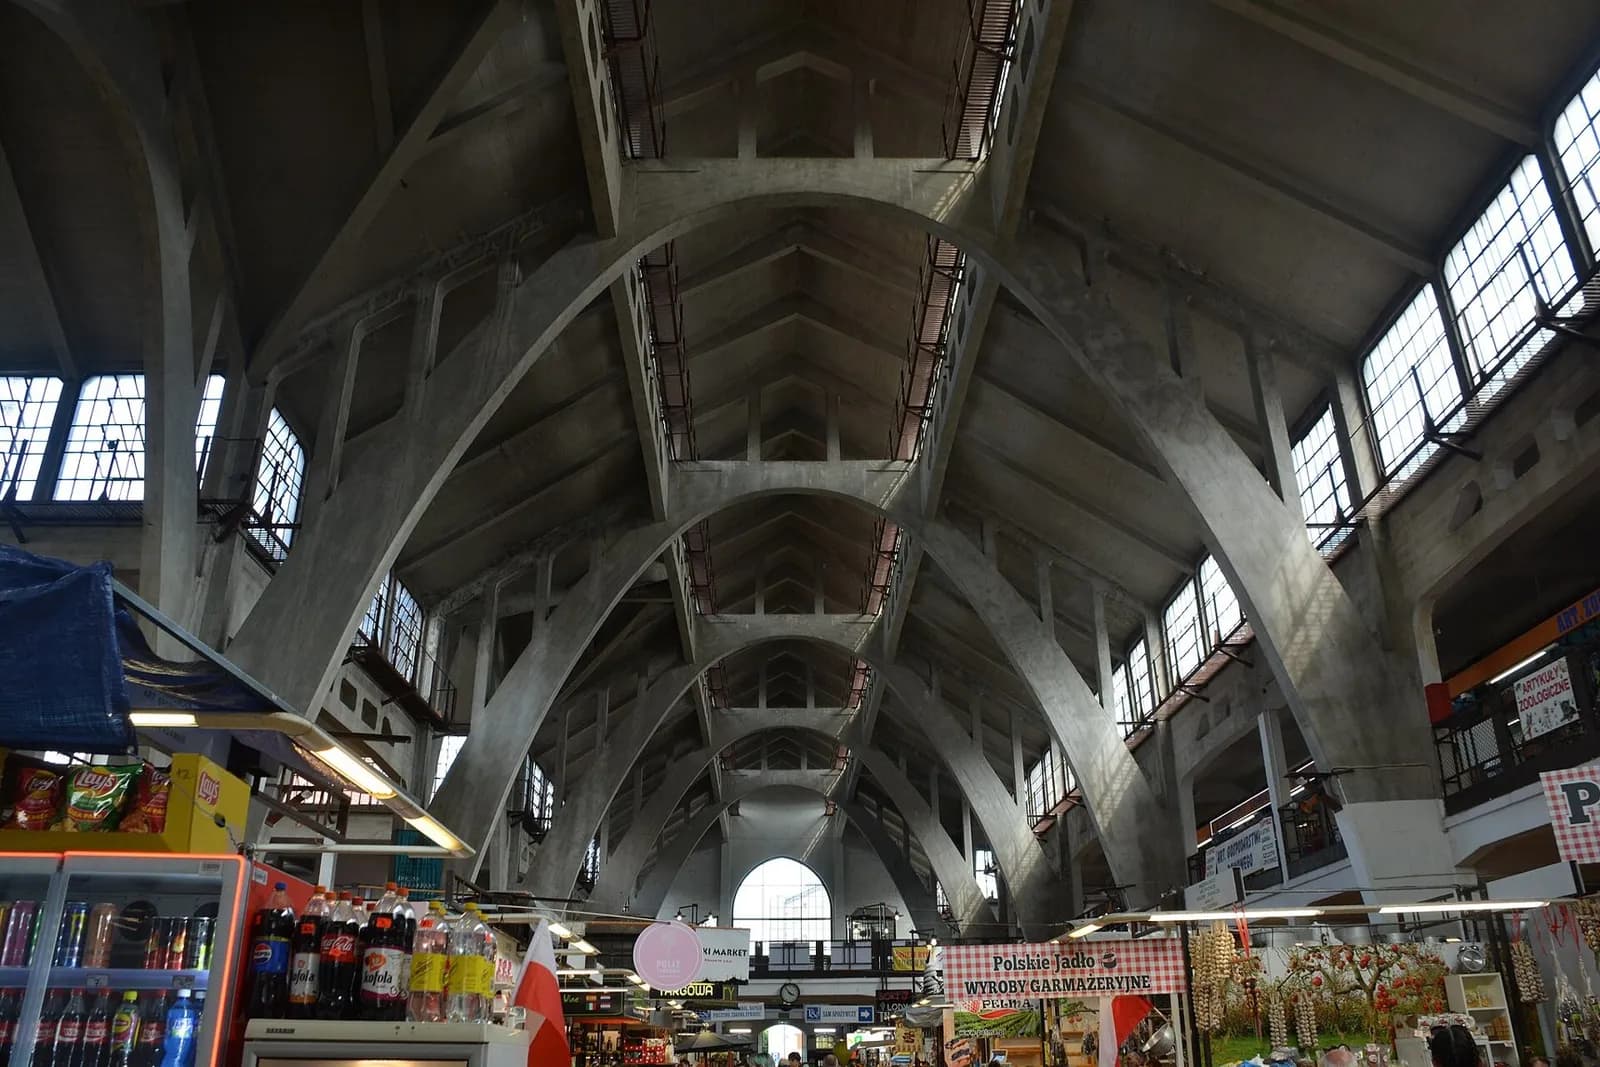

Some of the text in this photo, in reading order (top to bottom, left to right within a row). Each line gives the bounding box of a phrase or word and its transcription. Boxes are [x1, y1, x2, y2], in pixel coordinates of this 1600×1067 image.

[1521, 665, 1559, 694] ARTYKUŁY
[1518, 678, 1570, 712] ZOOLOGICZNE
[76, 770, 114, 790] Lay's
[200, 773, 219, 803] Lay's
[1560, 781, 1600, 824] P
[712, 948, 747, 957] MARKET
[993, 952, 1095, 973] Polskie Jadło
[964, 973, 1151, 995] WYROBY GARMAŻERYJNE
